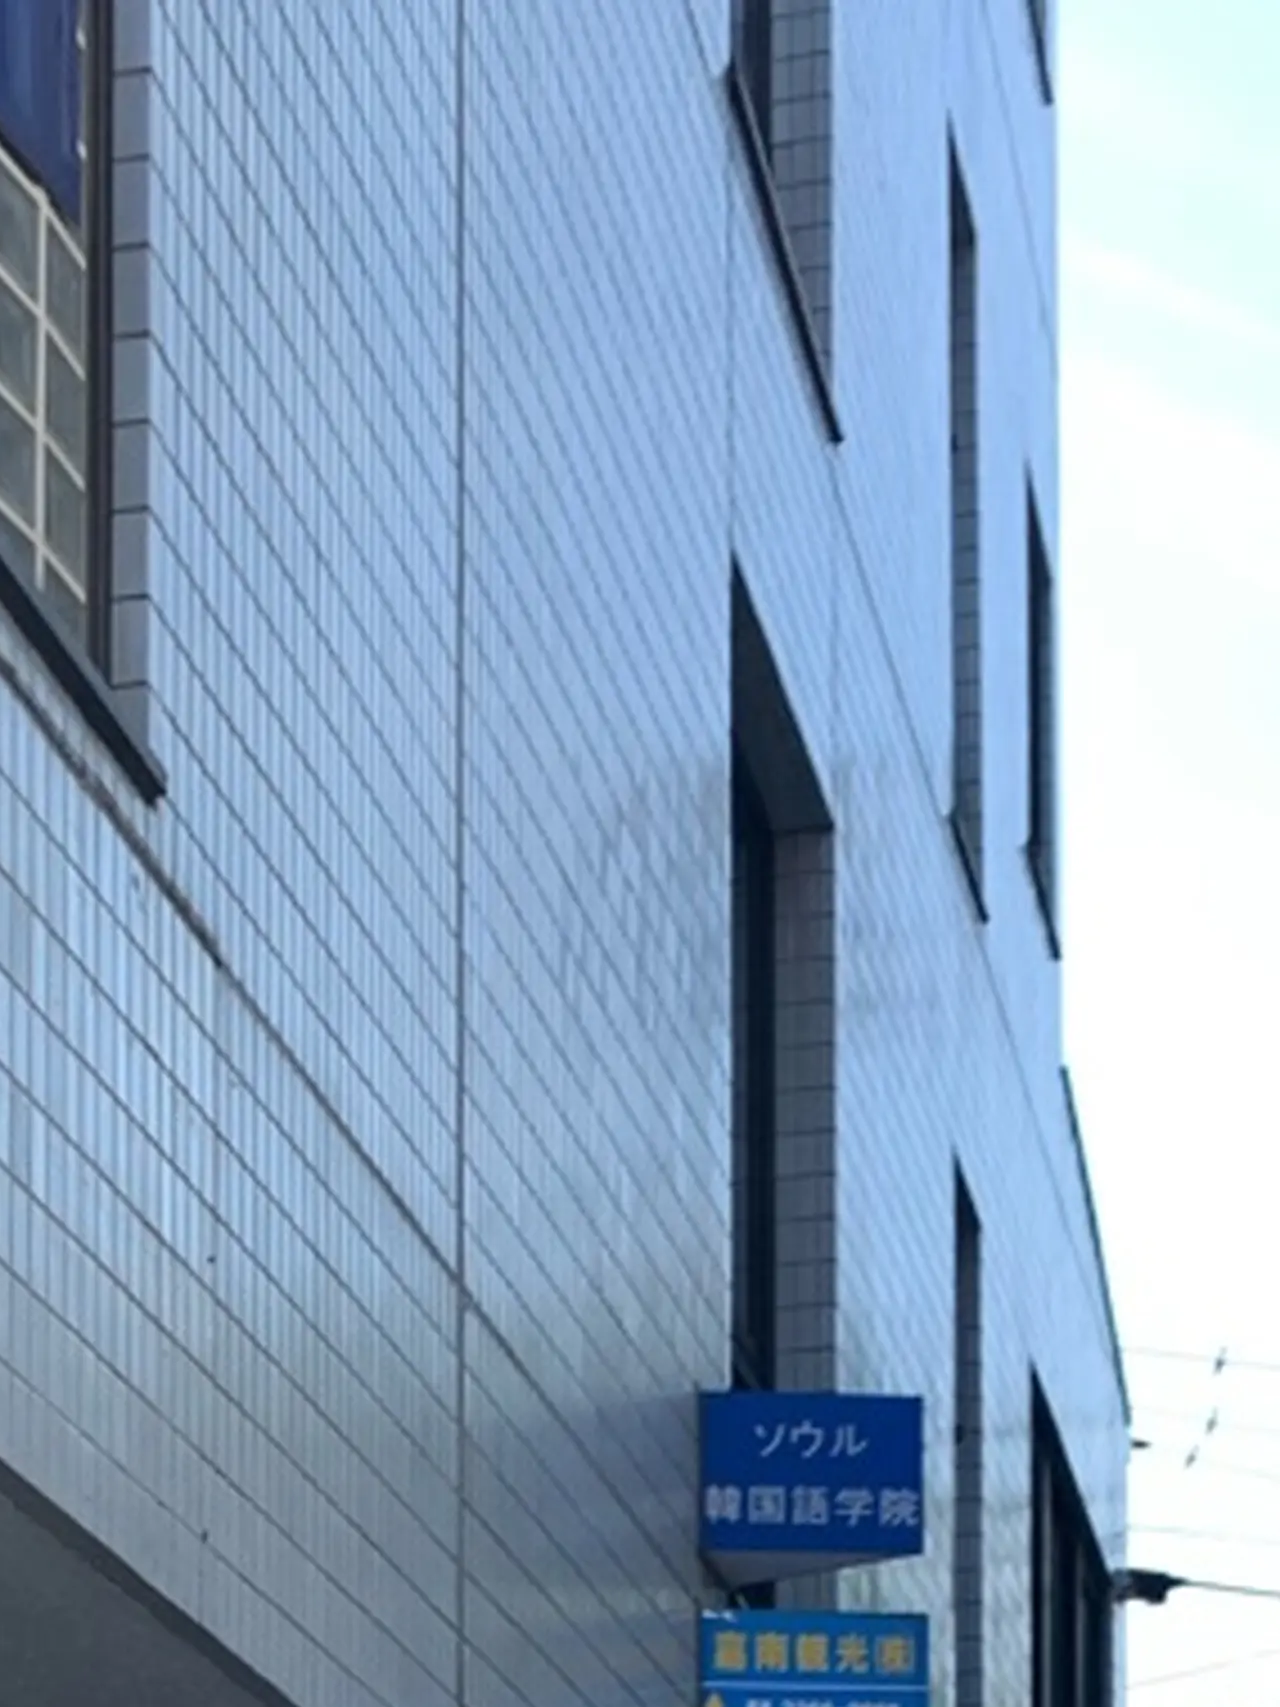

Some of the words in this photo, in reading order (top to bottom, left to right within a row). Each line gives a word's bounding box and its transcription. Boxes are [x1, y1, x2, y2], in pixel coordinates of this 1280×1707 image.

[753, 1420, 869, 1459] ソウル
[705, 1484, 920, 1527] 韓国語学院
